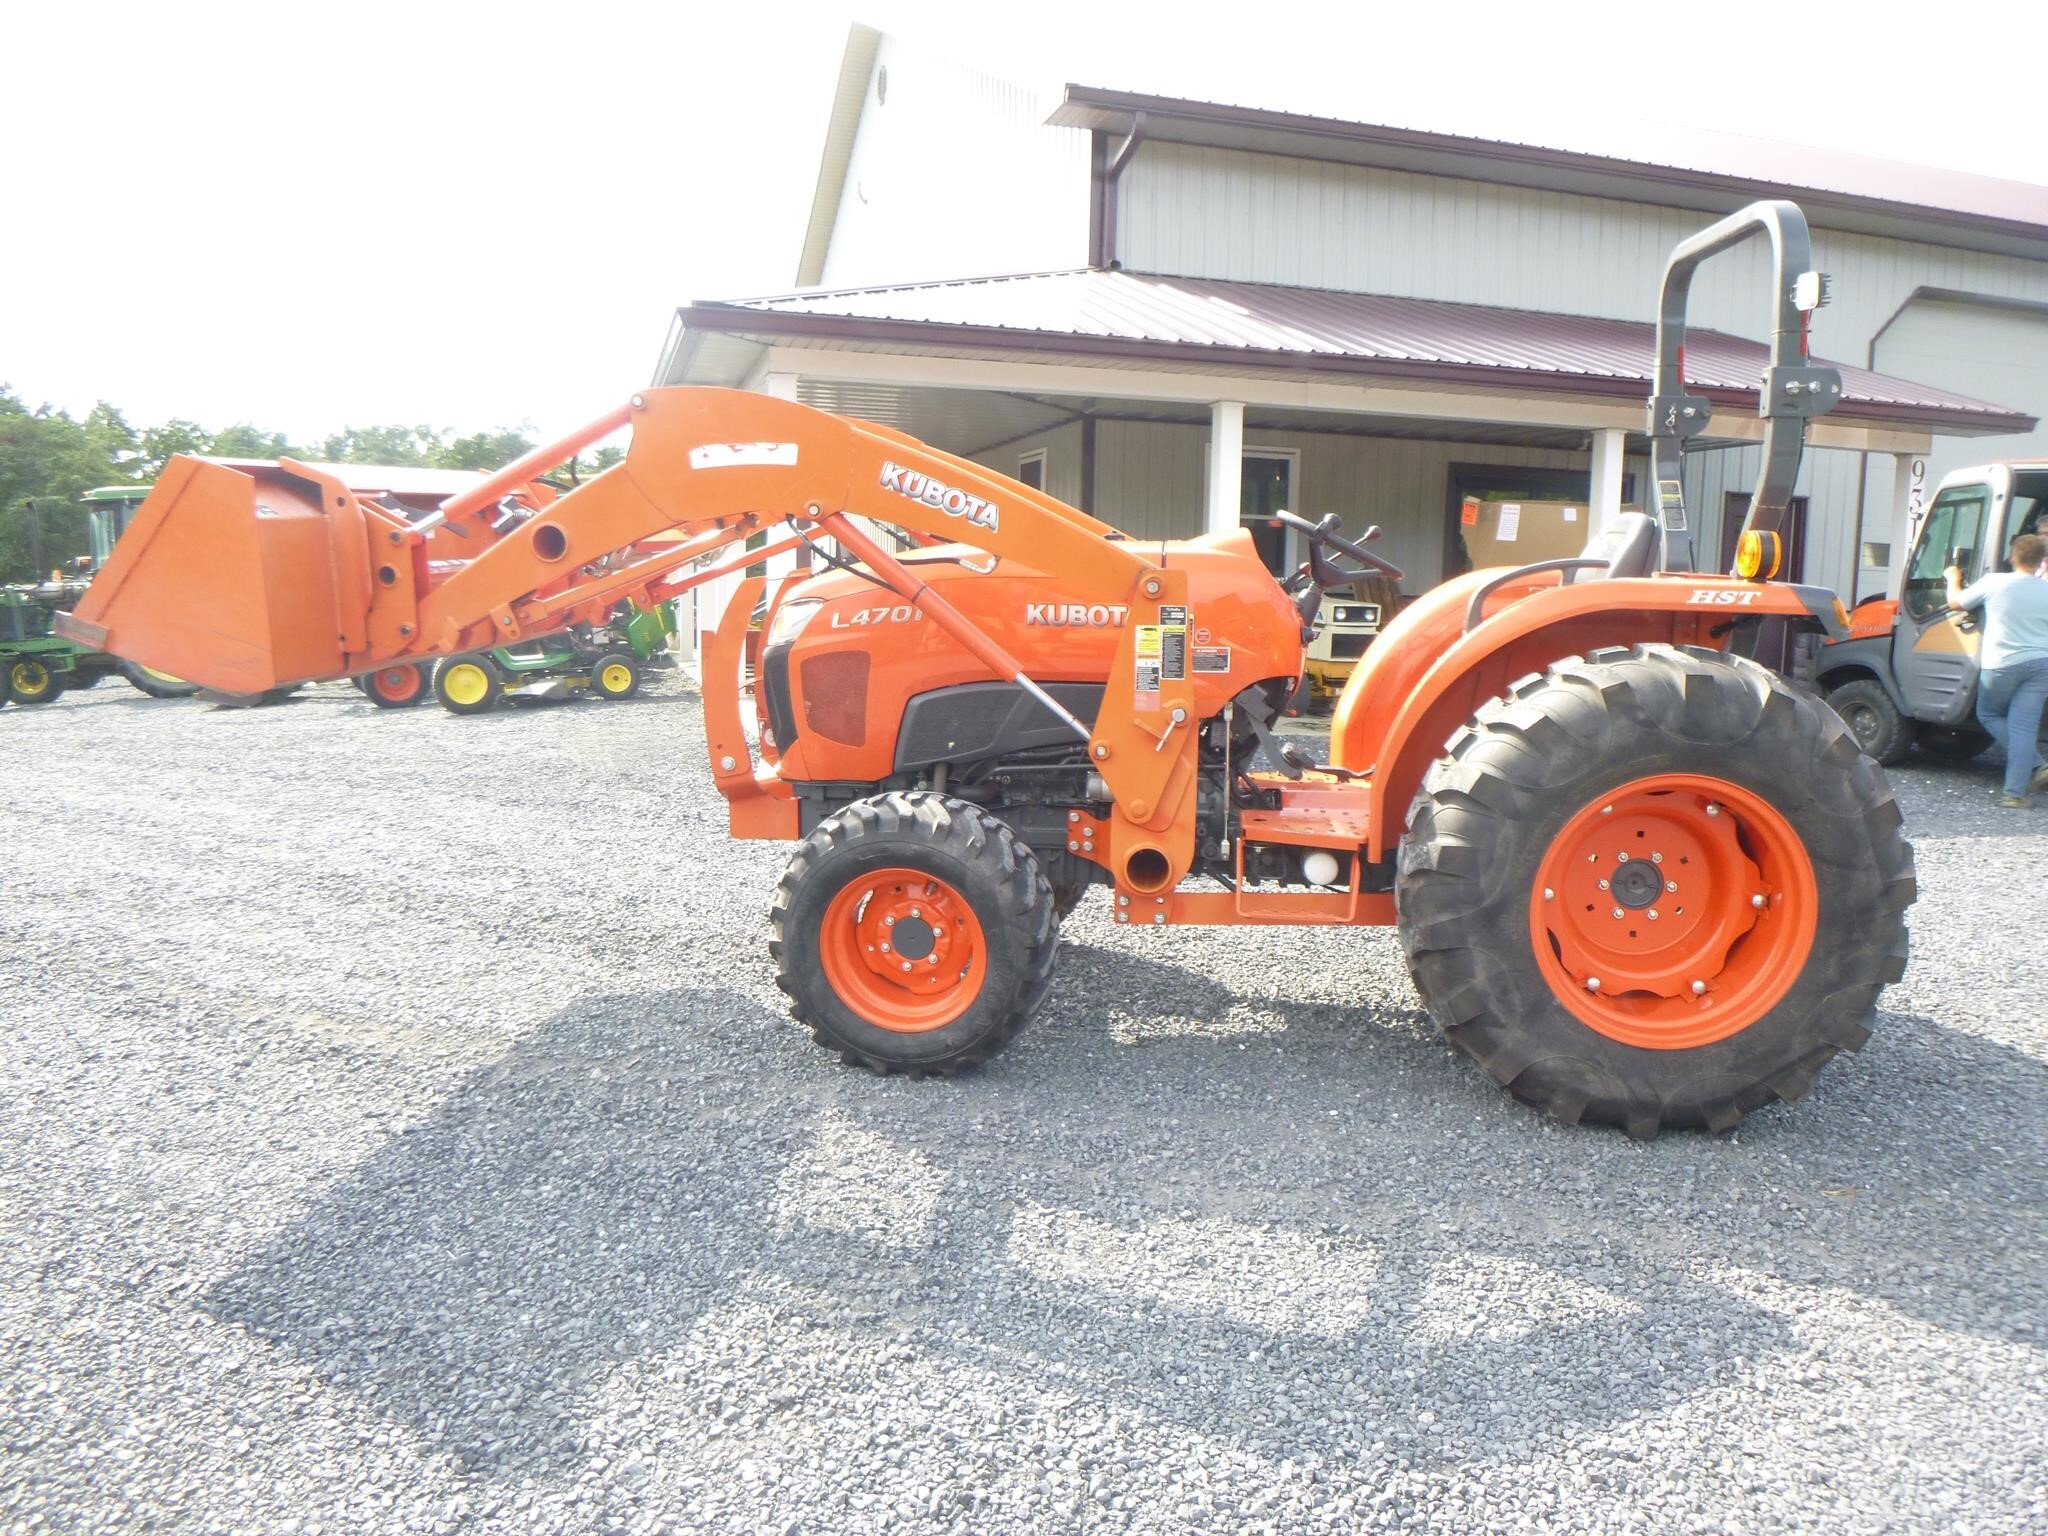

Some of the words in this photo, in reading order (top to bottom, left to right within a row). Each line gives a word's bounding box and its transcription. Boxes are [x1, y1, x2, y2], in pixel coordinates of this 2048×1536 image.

[879, 461, 998, 532] KUBOTA
[1686, 589, 1762, 605] HST
[1026, 603, 1131, 627] KUBOT
